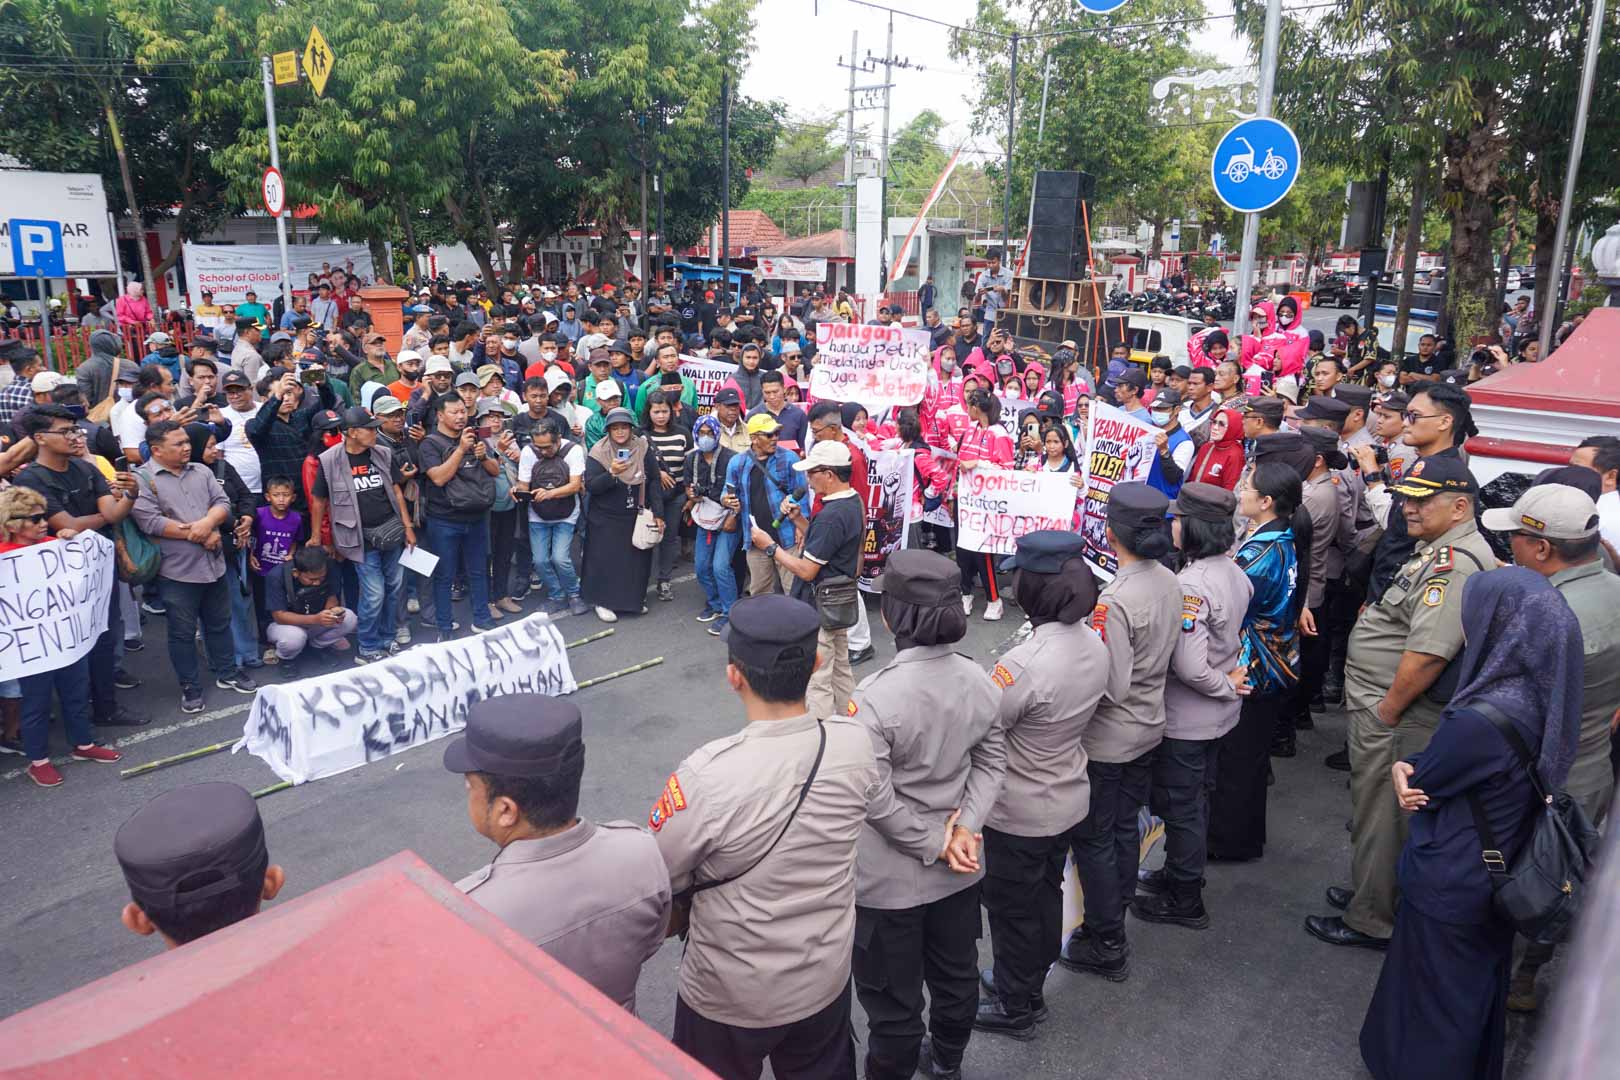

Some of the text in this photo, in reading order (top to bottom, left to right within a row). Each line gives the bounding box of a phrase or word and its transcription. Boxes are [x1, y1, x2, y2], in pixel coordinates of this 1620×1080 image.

[267, 184, 277, 203] 50
[19, 225, 54, 266] P
[199, 273, 280, 282] School of Global
[816, 323, 903, 345] Jangan
[683, 368, 706, 379] WALI
[1094, 418, 1139, 446] KEADILAN
[1096, 440, 1123, 456] UNTUK
[1090, 452, 1125, 480] ATLET!
[960, 493, 1008, 514] diatas
